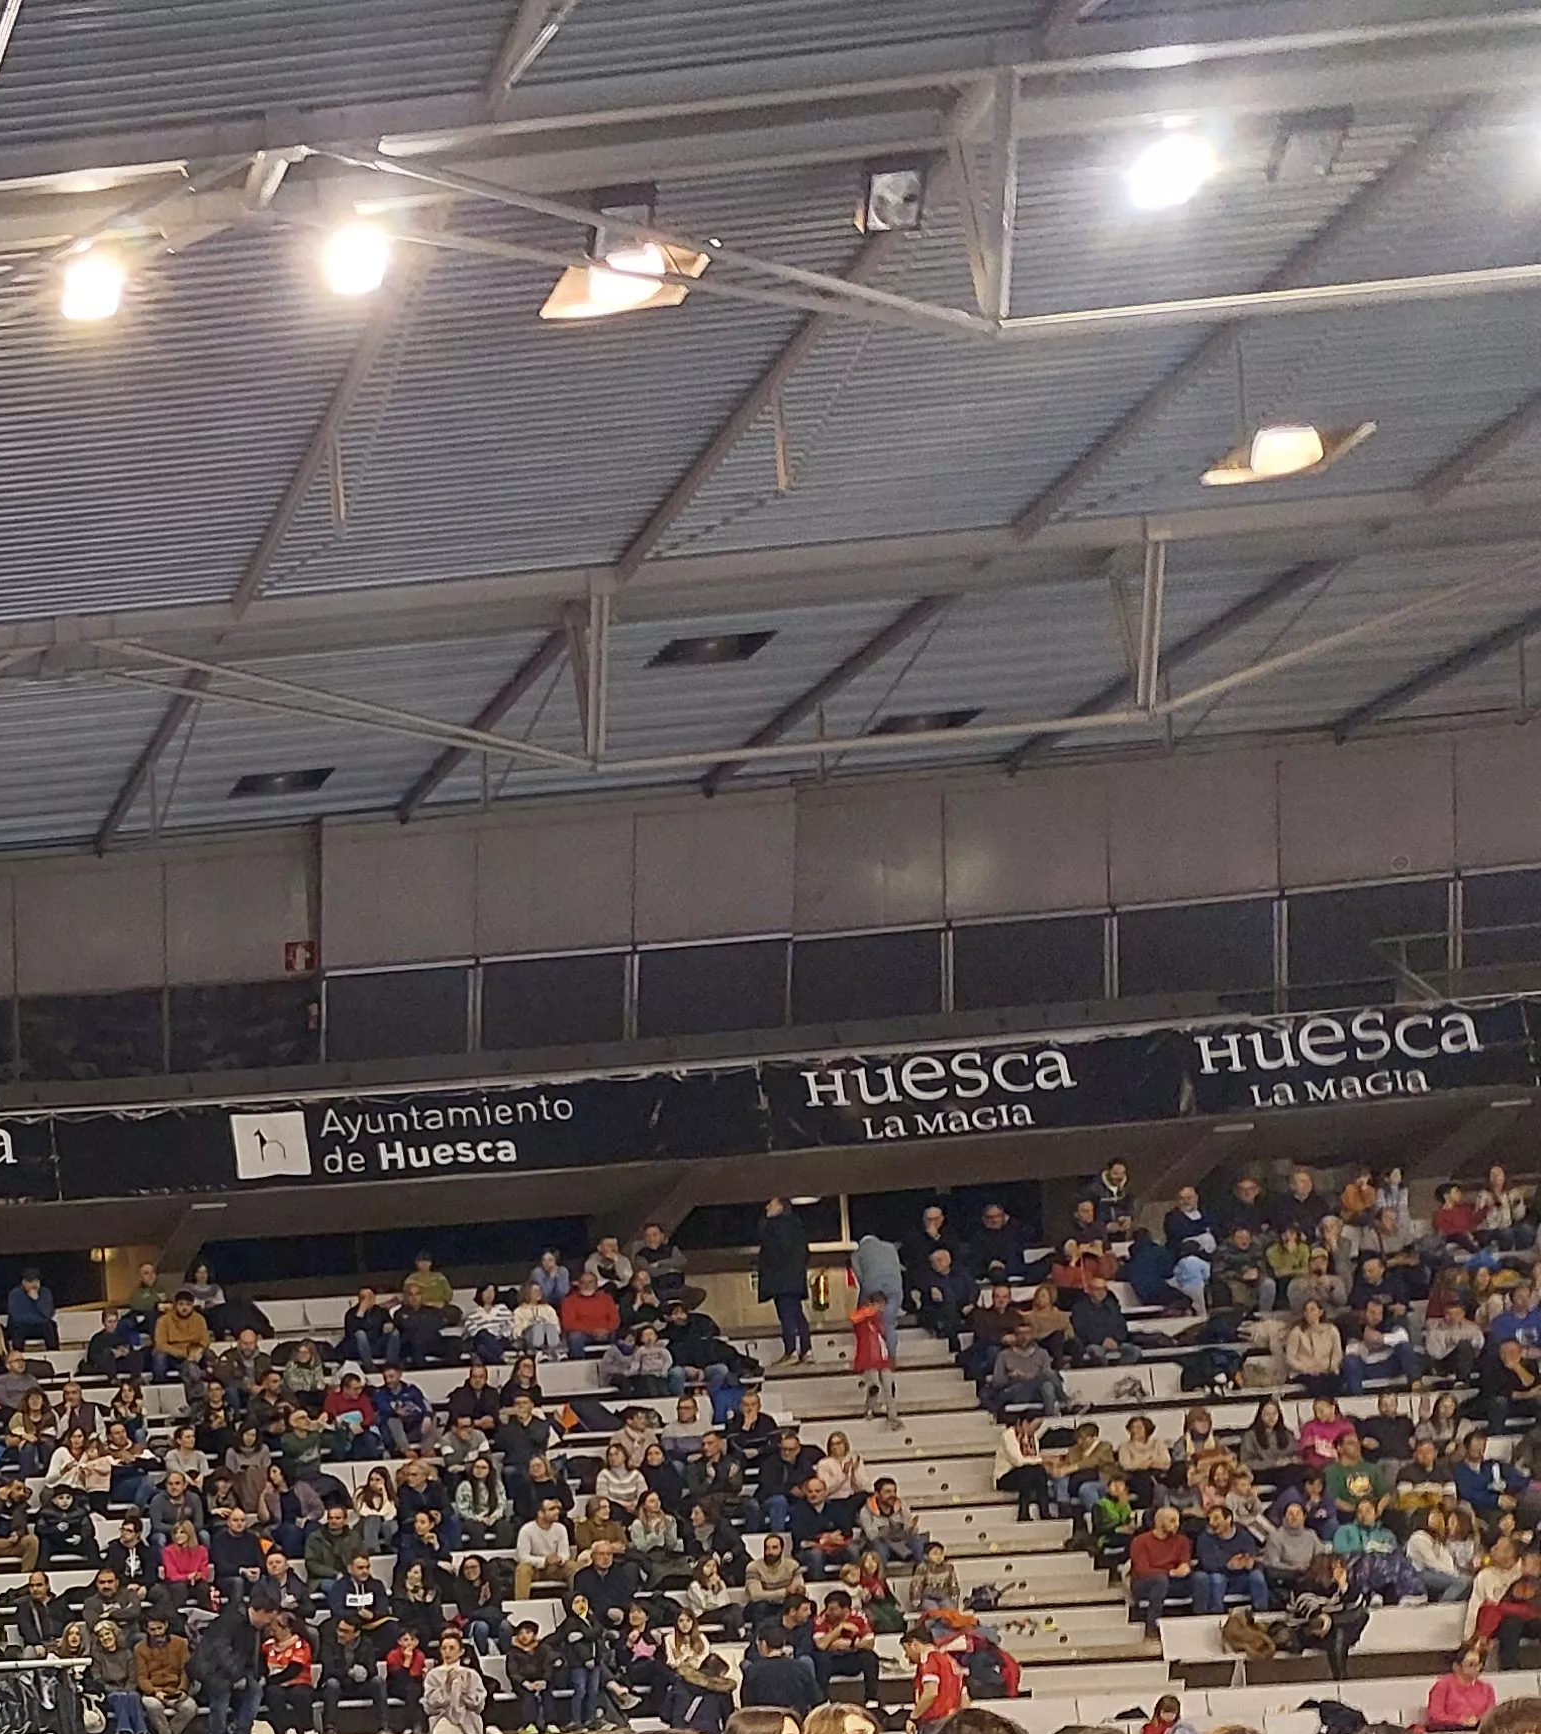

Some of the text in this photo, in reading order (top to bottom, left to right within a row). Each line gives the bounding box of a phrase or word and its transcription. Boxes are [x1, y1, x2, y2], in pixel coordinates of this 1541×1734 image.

[1195, 1008, 1485, 1077] Huesca
[800, 1047, 1077, 1109] Huesca
[1249, 1079, 1296, 1107] La
[320, 1094, 575, 1140] Ayuntamiento
[862, 1112, 910, 1141] La
[324, 1136, 518, 1175] de Huesca
